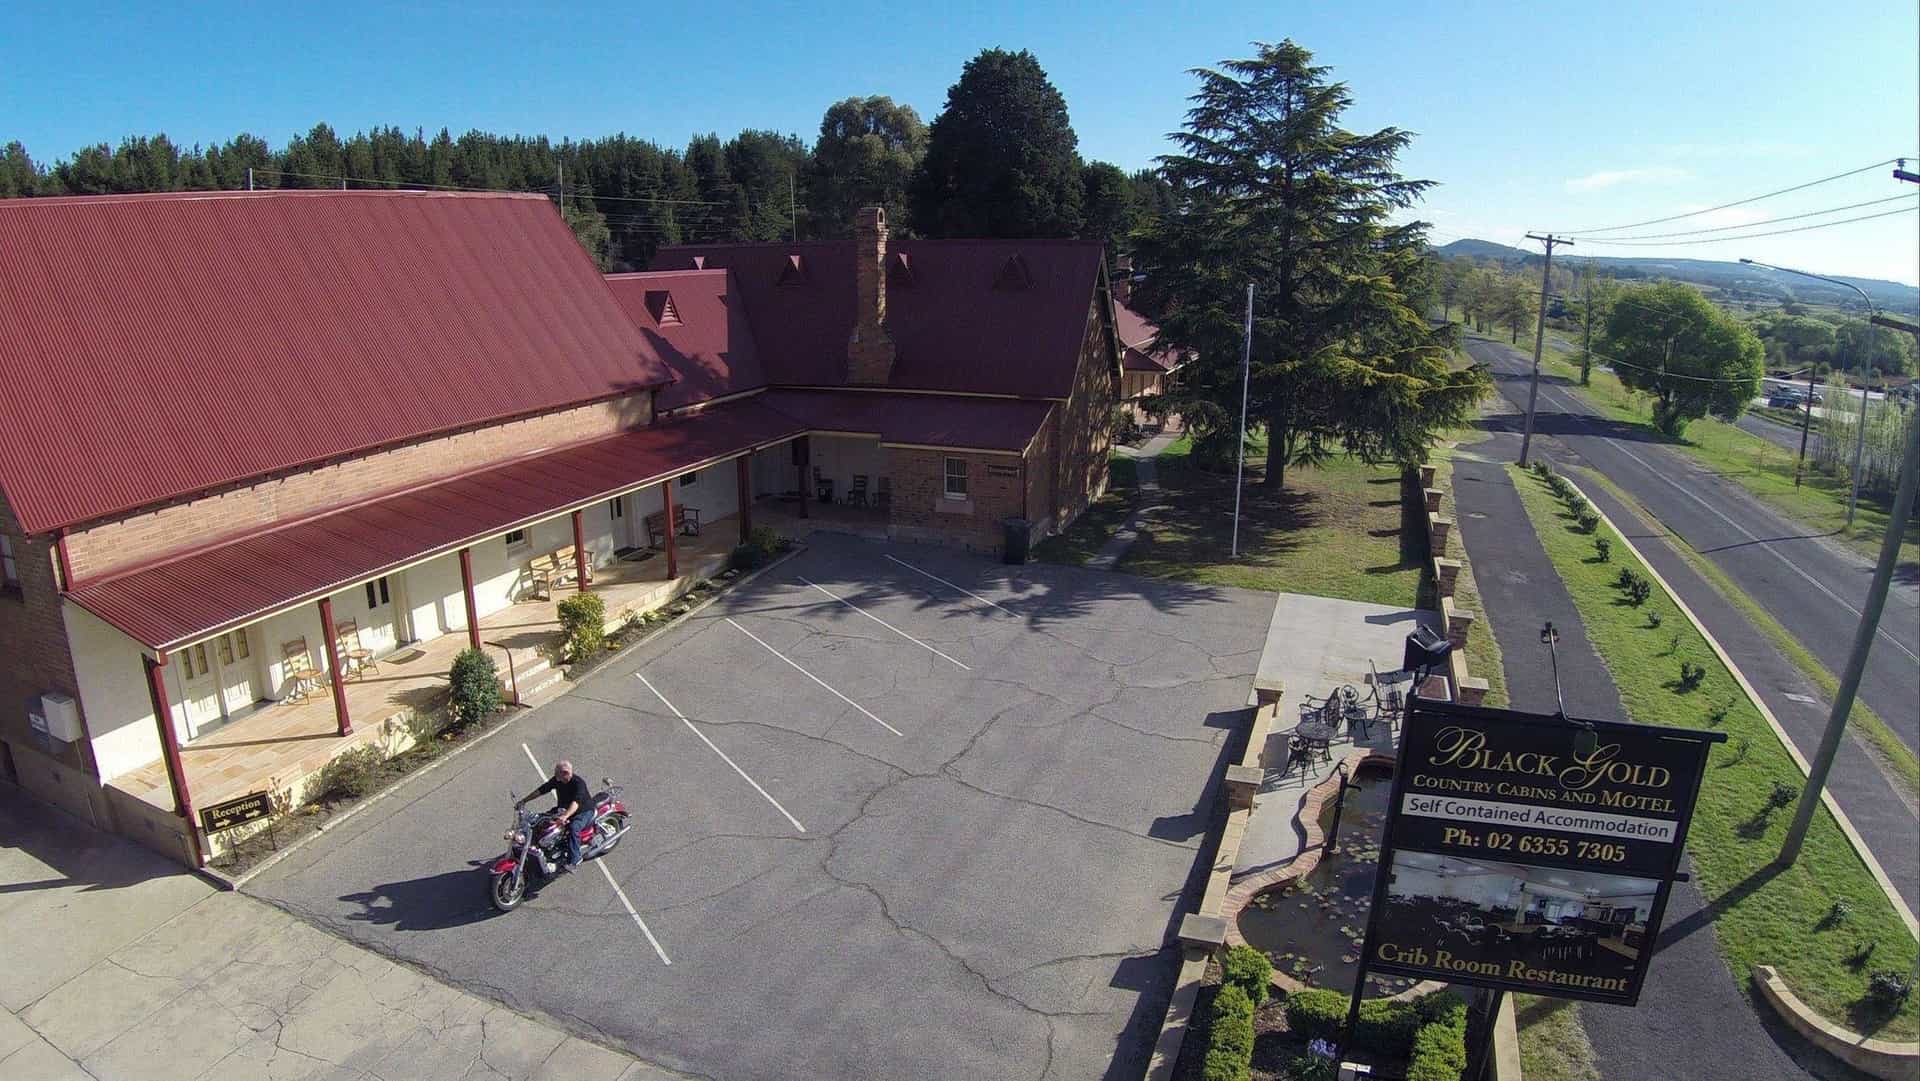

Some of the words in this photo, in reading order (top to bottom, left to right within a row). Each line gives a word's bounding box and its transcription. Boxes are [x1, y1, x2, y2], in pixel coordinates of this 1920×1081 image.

[1429, 726, 1560, 777] BLACK
[1559, 743, 1671, 790] GOLD
[212, 799, 261, 819] Reception
[1413, 774, 1494, 794] COUNTRY
[1497, 782, 1556, 801] CABINS
[1560, 791, 1596, 805] AND
[1600, 790, 1676, 813] MOTEL
[1408, 798, 1443, 813] Self
[1445, 801, 1531, 823] Contained
[1534, 810, 1669, 838] Accommodation
[1442, 827, 1480, 847] Ph:
[1486, 832, 1512, 850] 02
[1519, 835, 1569, 857] 6355
[1576, 842, 1626, 863] 7305
[1377, 943, 1429, 966] Crib
[1434, 949, 1501, 976] Room
[1508, 960, 1628, 993] Restaurant
